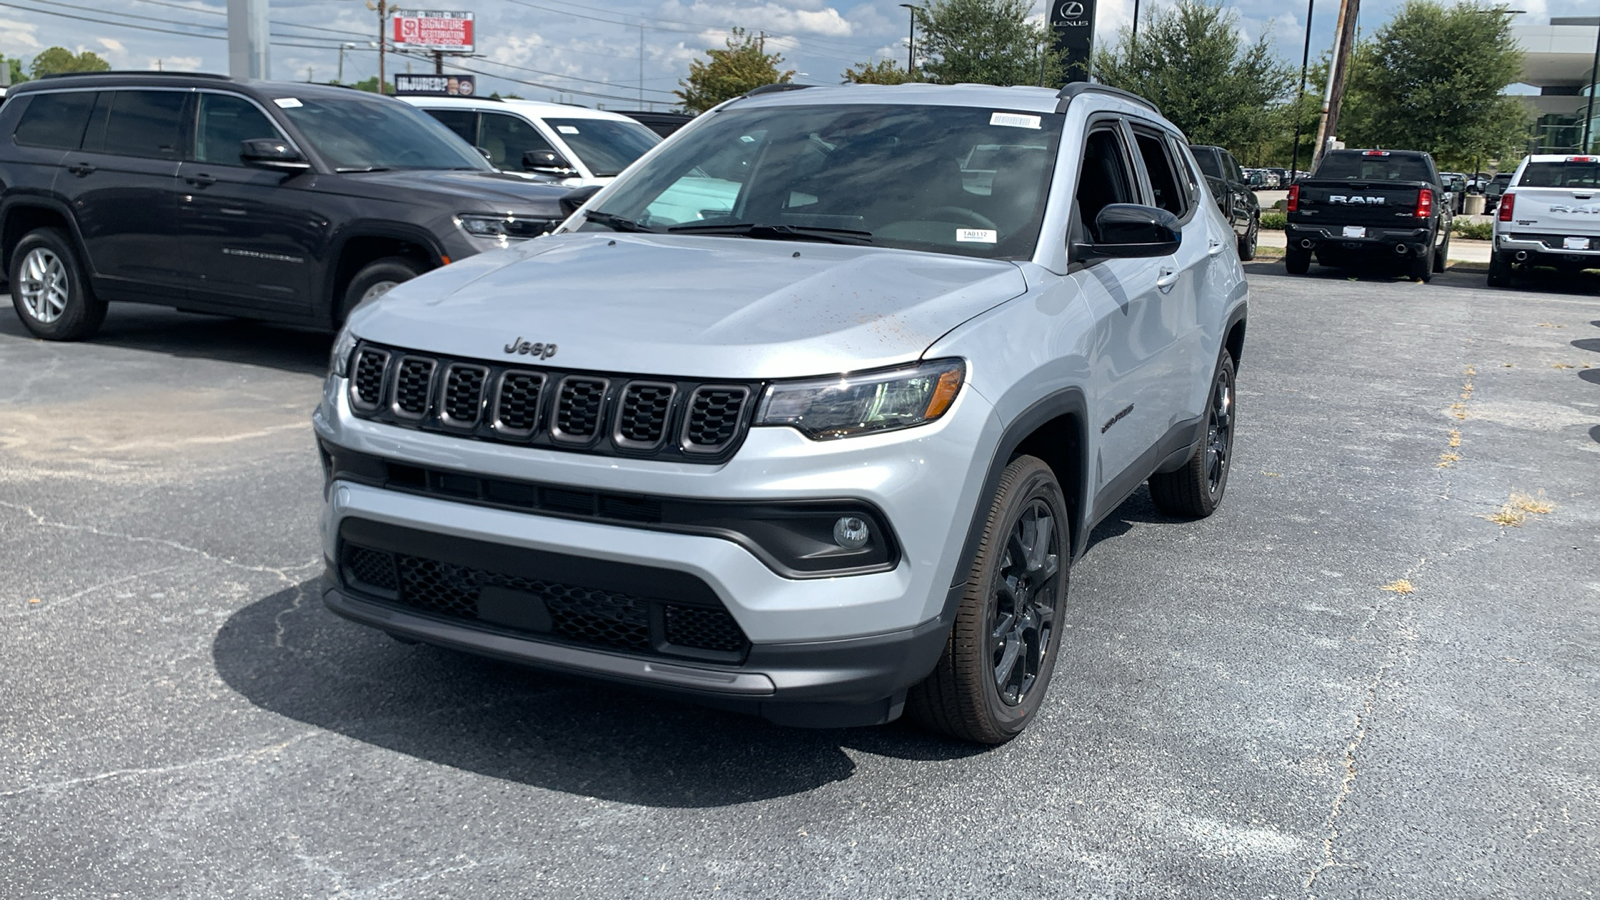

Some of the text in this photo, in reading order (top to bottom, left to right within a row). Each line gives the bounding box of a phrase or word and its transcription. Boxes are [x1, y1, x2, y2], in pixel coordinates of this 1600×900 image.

[420, 19, 465, 30] SIGNATURE
[420, 29, 465, 39] RESTORATION
[397, 76, 449, 91] INJURED?
[1329, 195, 1385, 205] RAM
[504, 336, 558, 361] Jeep
